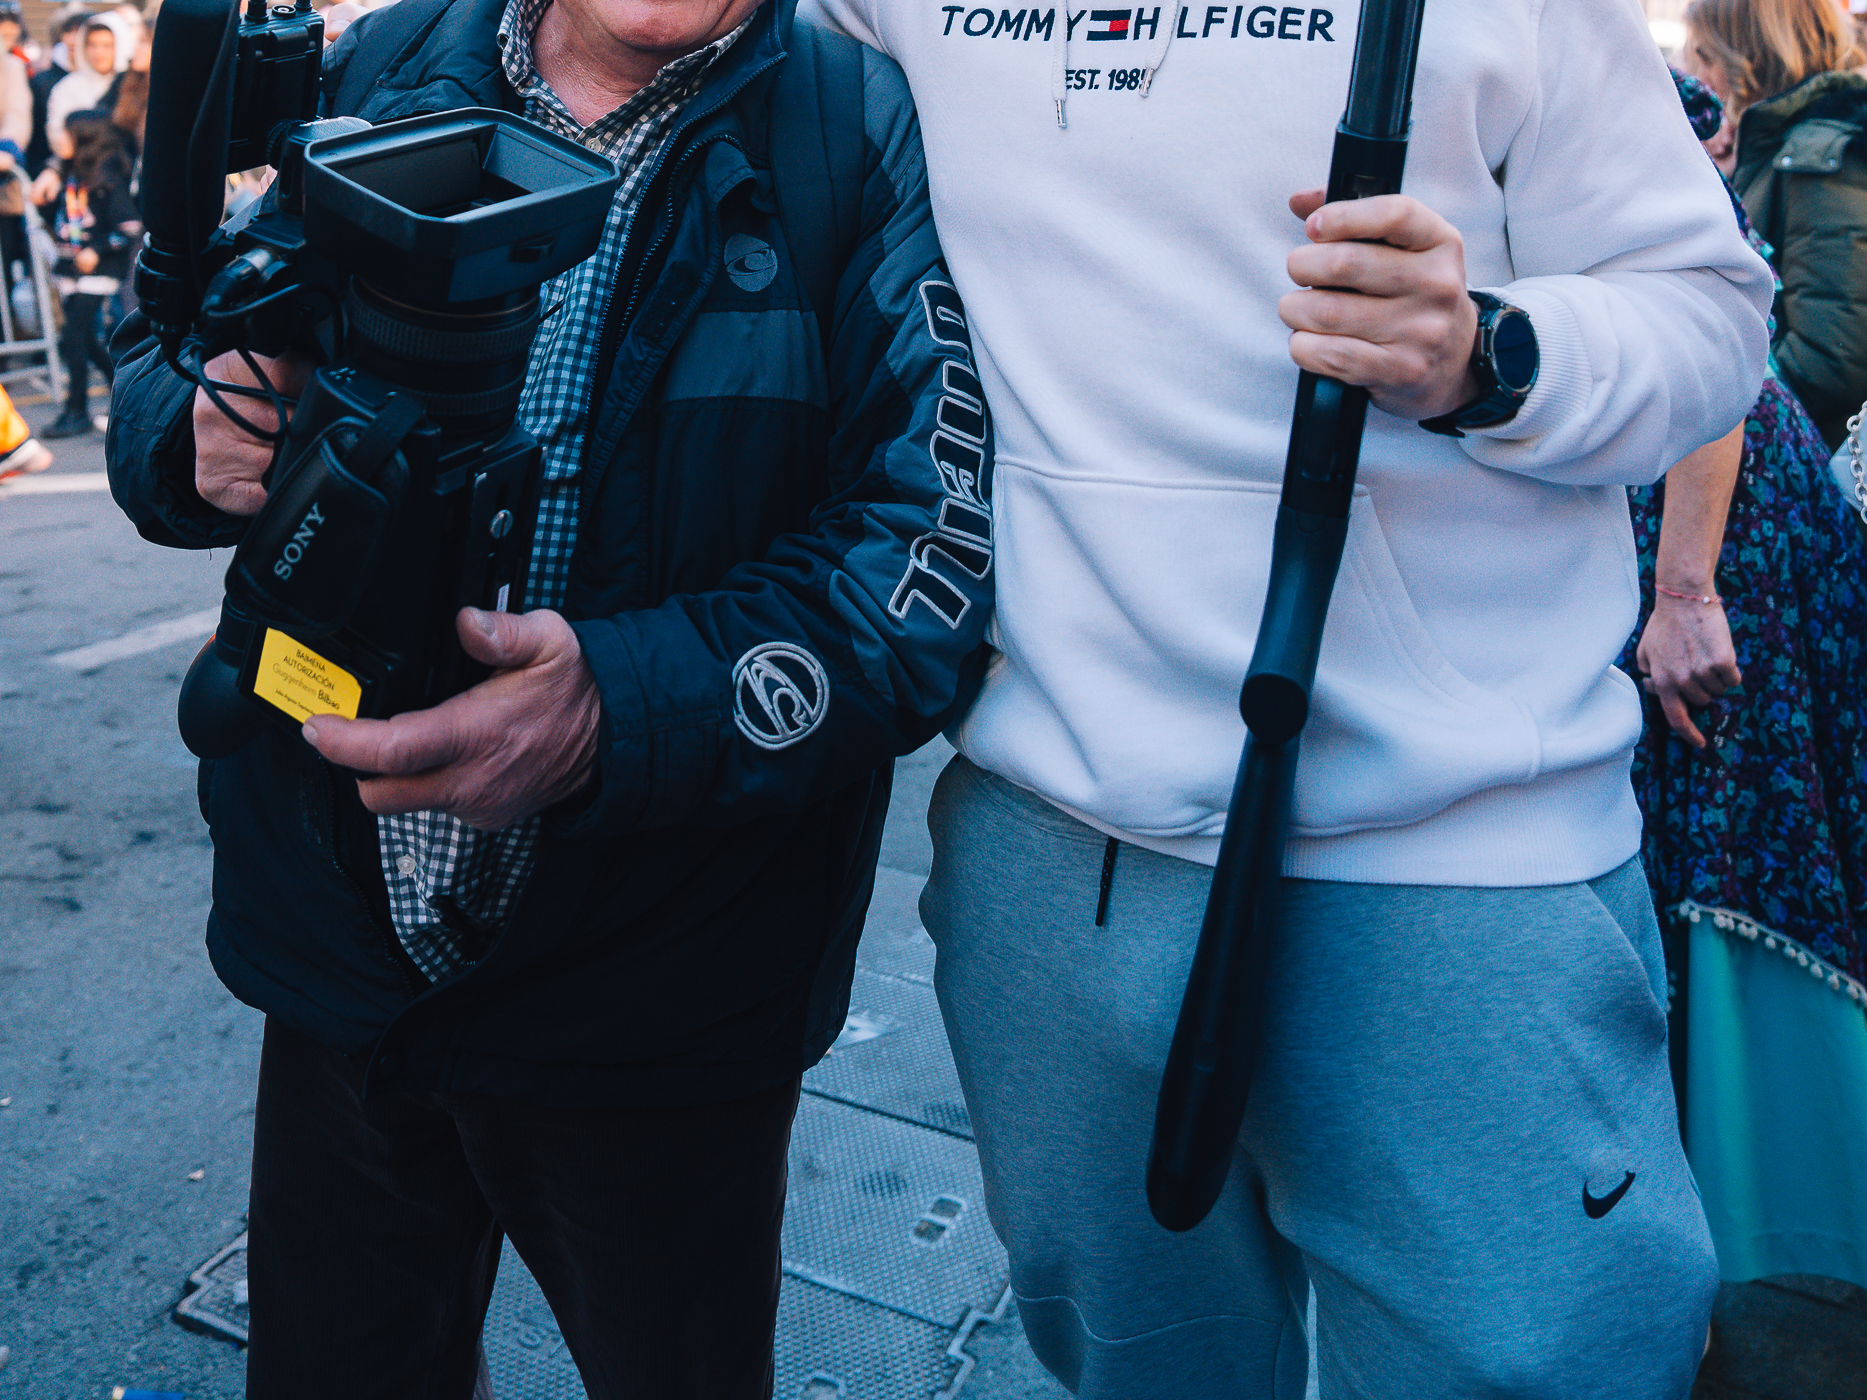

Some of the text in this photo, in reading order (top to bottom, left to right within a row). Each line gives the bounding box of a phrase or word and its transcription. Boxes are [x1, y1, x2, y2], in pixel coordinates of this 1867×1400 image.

[941, 5, 1335, 42] TOMMY HLFIGER
[1064, 68, 1099, 91] EST.
[273, 501, 326, 581] SONY
[283, 655, 335, 691] AUTORIZACIÓN
[317, 689, 341, 710] Bilbao
